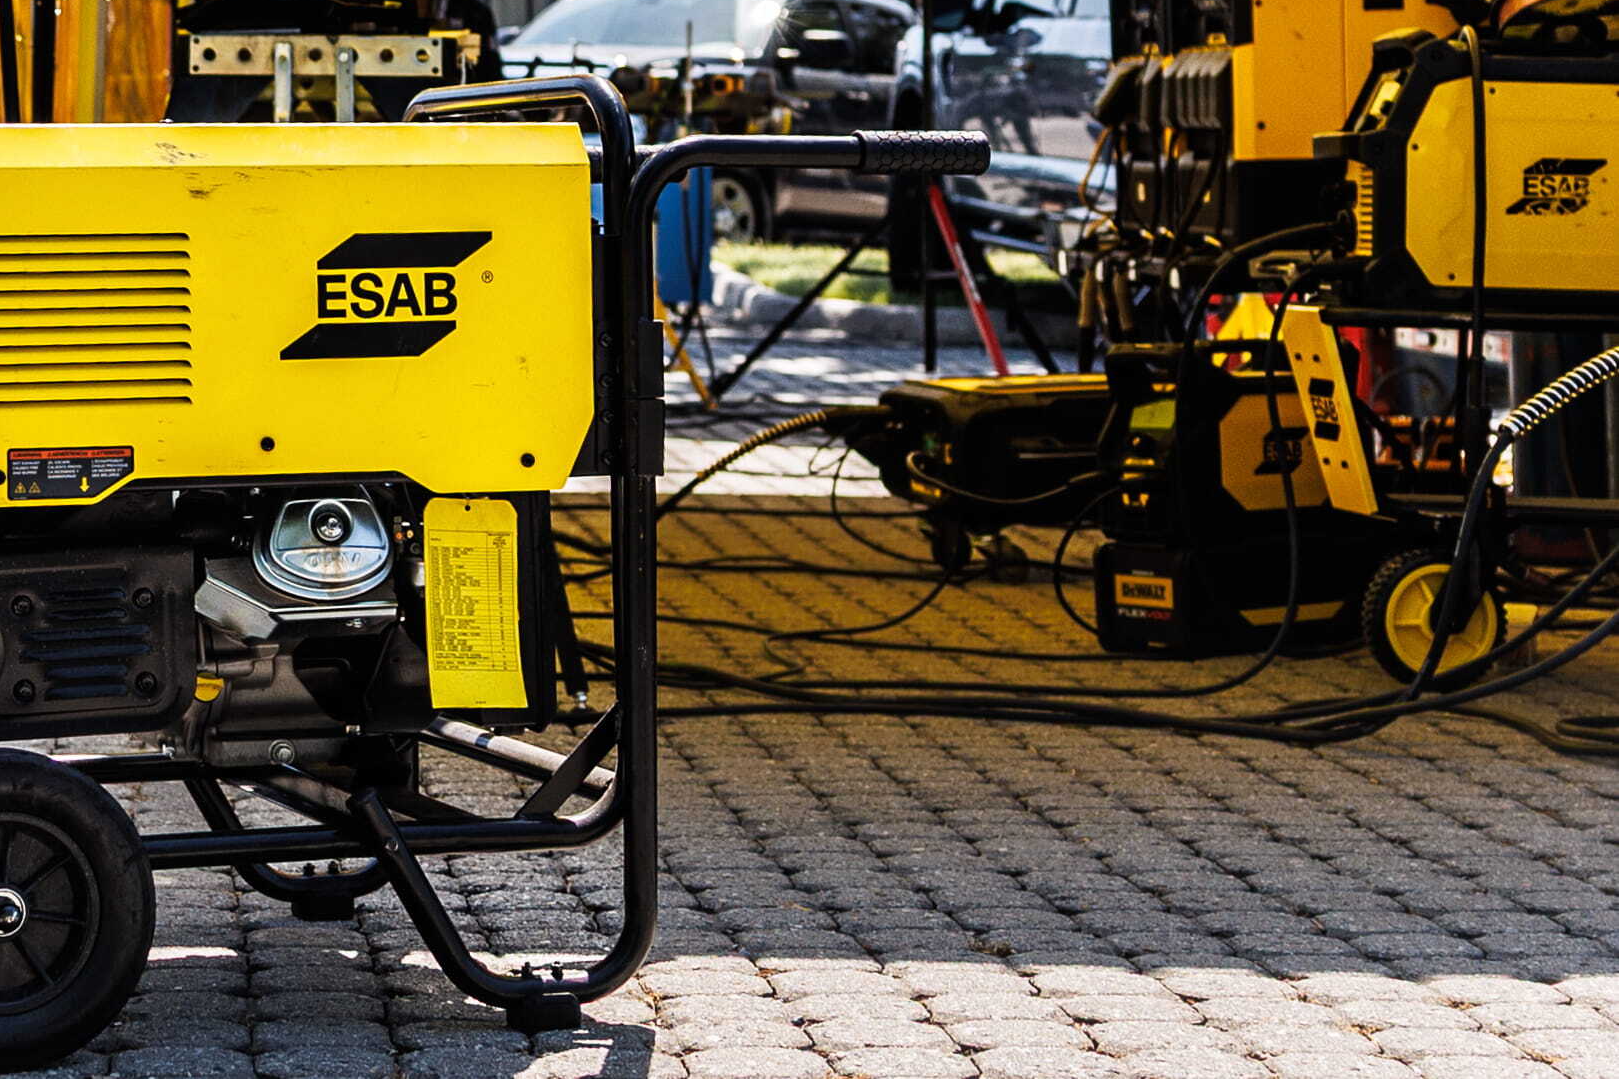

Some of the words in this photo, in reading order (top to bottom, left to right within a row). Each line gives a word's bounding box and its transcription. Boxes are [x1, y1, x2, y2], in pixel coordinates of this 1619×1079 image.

[1523, 176, 1590, 197] ESAB
[316, 272, 458, 319] ESAB
[1311, 397, 1339, 422] ESAB
